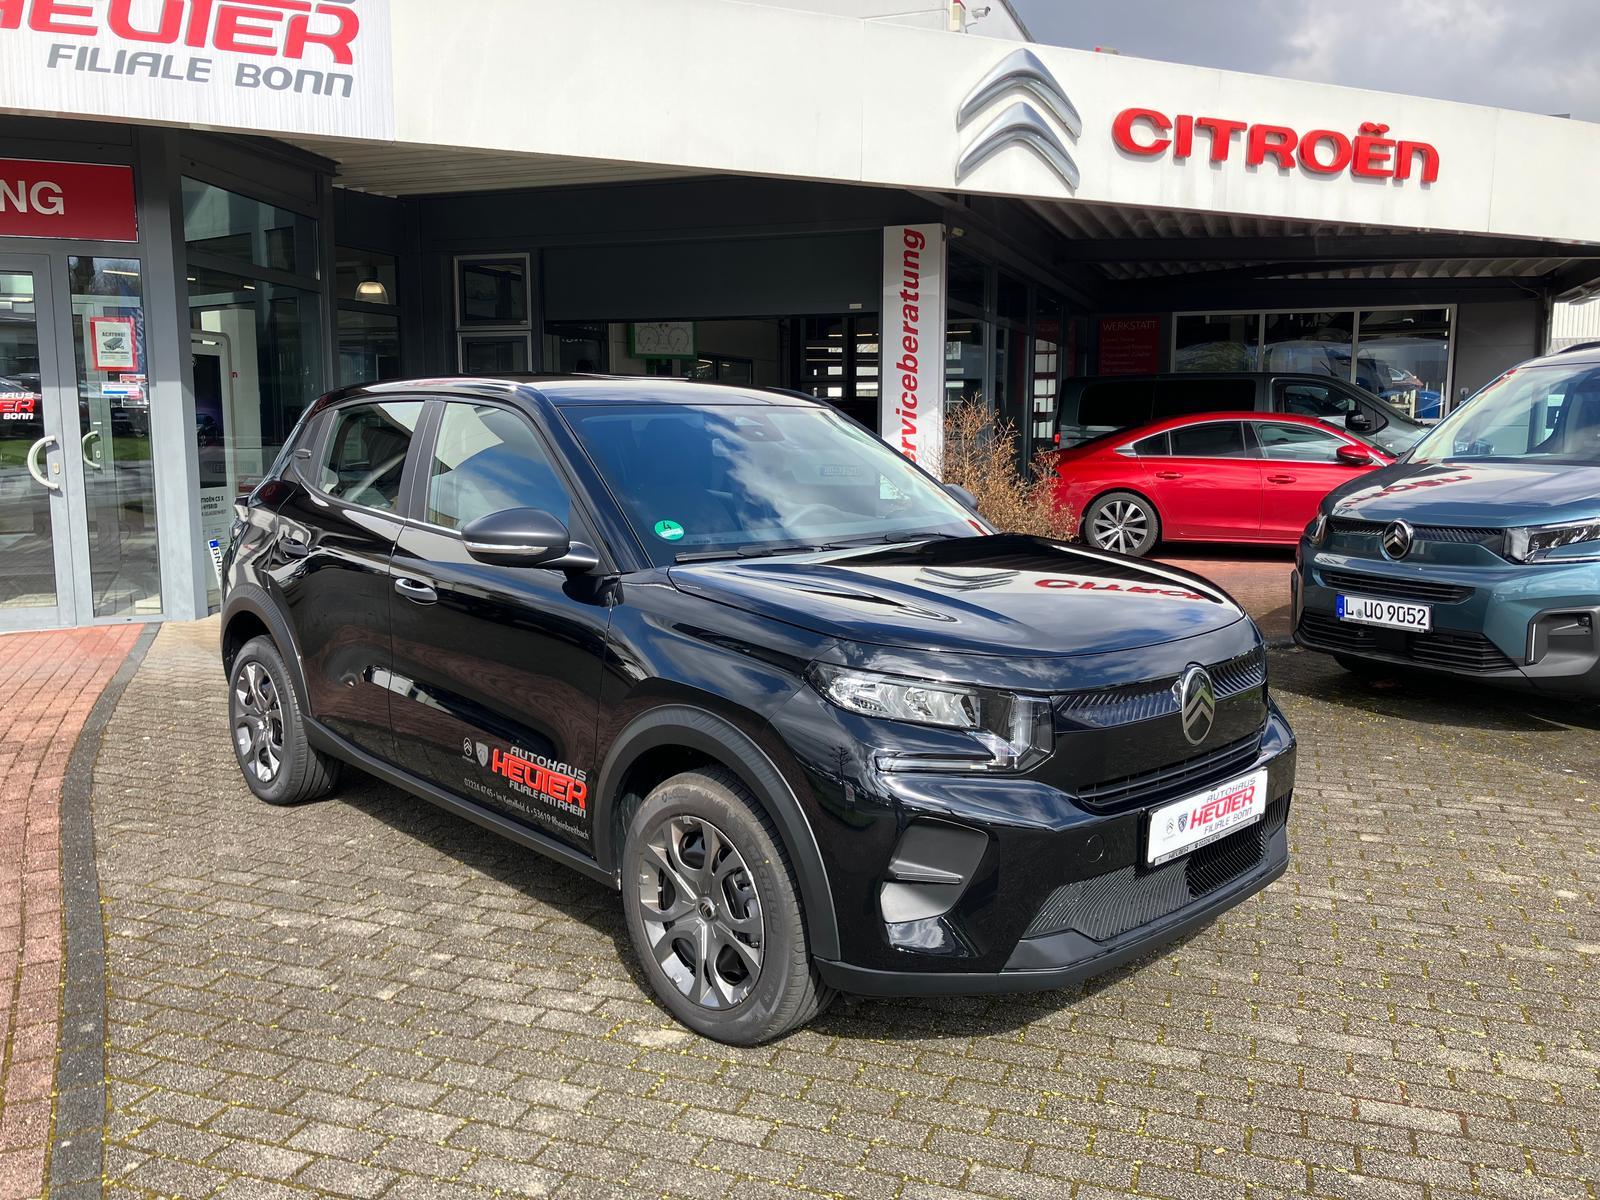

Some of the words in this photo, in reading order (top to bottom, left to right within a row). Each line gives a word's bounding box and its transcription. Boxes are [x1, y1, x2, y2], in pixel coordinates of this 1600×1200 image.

[47, 43, 212, 83] FILIALE
[1112, 107, 1440, 185] CITROËN
[0, 179, 64, 215] NG
[1102, 320, 1156, 331] WERKSTATT
[896, 227, 926, 464] erviceberatung
[1345, 592, 1355, 616] L
[1364, 601, 1383, 620] UO
[1387, 604, 1427, 627] 9052
[491, 748, 588, 809] HEUTER
[510, 746, 587, 781] AUTOHAUS
[509, 779, 539, 799] FILIALE
[539, 792, 556, 807] AM
[557, 800, 587, 818] RHEIN
[1189, 785, 1256, 830] HEUTER
[1206, 776, 1257, 803] AUTOHAUS
[1204, 815, 1231, 835] FILIALE
